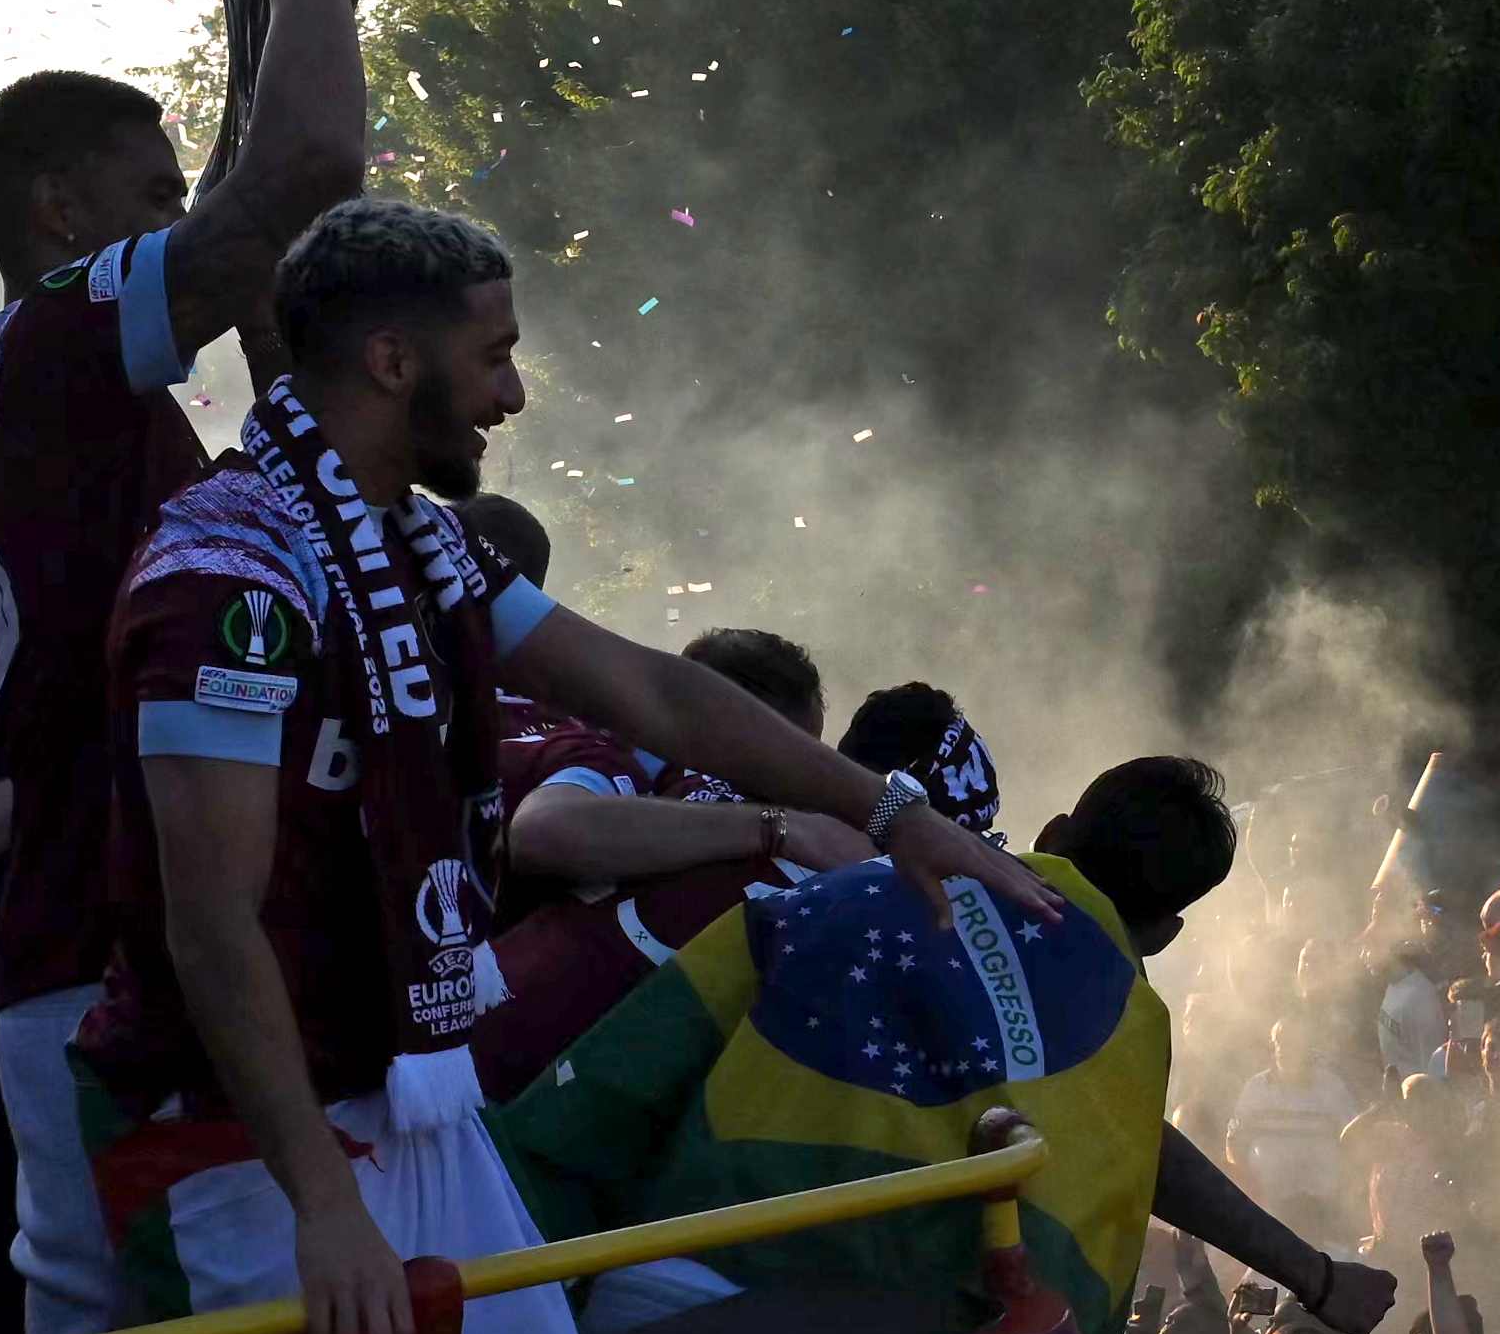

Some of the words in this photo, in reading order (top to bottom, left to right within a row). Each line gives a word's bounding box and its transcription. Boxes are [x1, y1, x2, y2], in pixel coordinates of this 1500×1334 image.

[257, 444, 336, 561] LEAGUE
[362, 655, 391, 738] 2023
[199, 677, 296, 702] FOUNDATION
[951, 890, 1038, 1066] PROGRESSO
